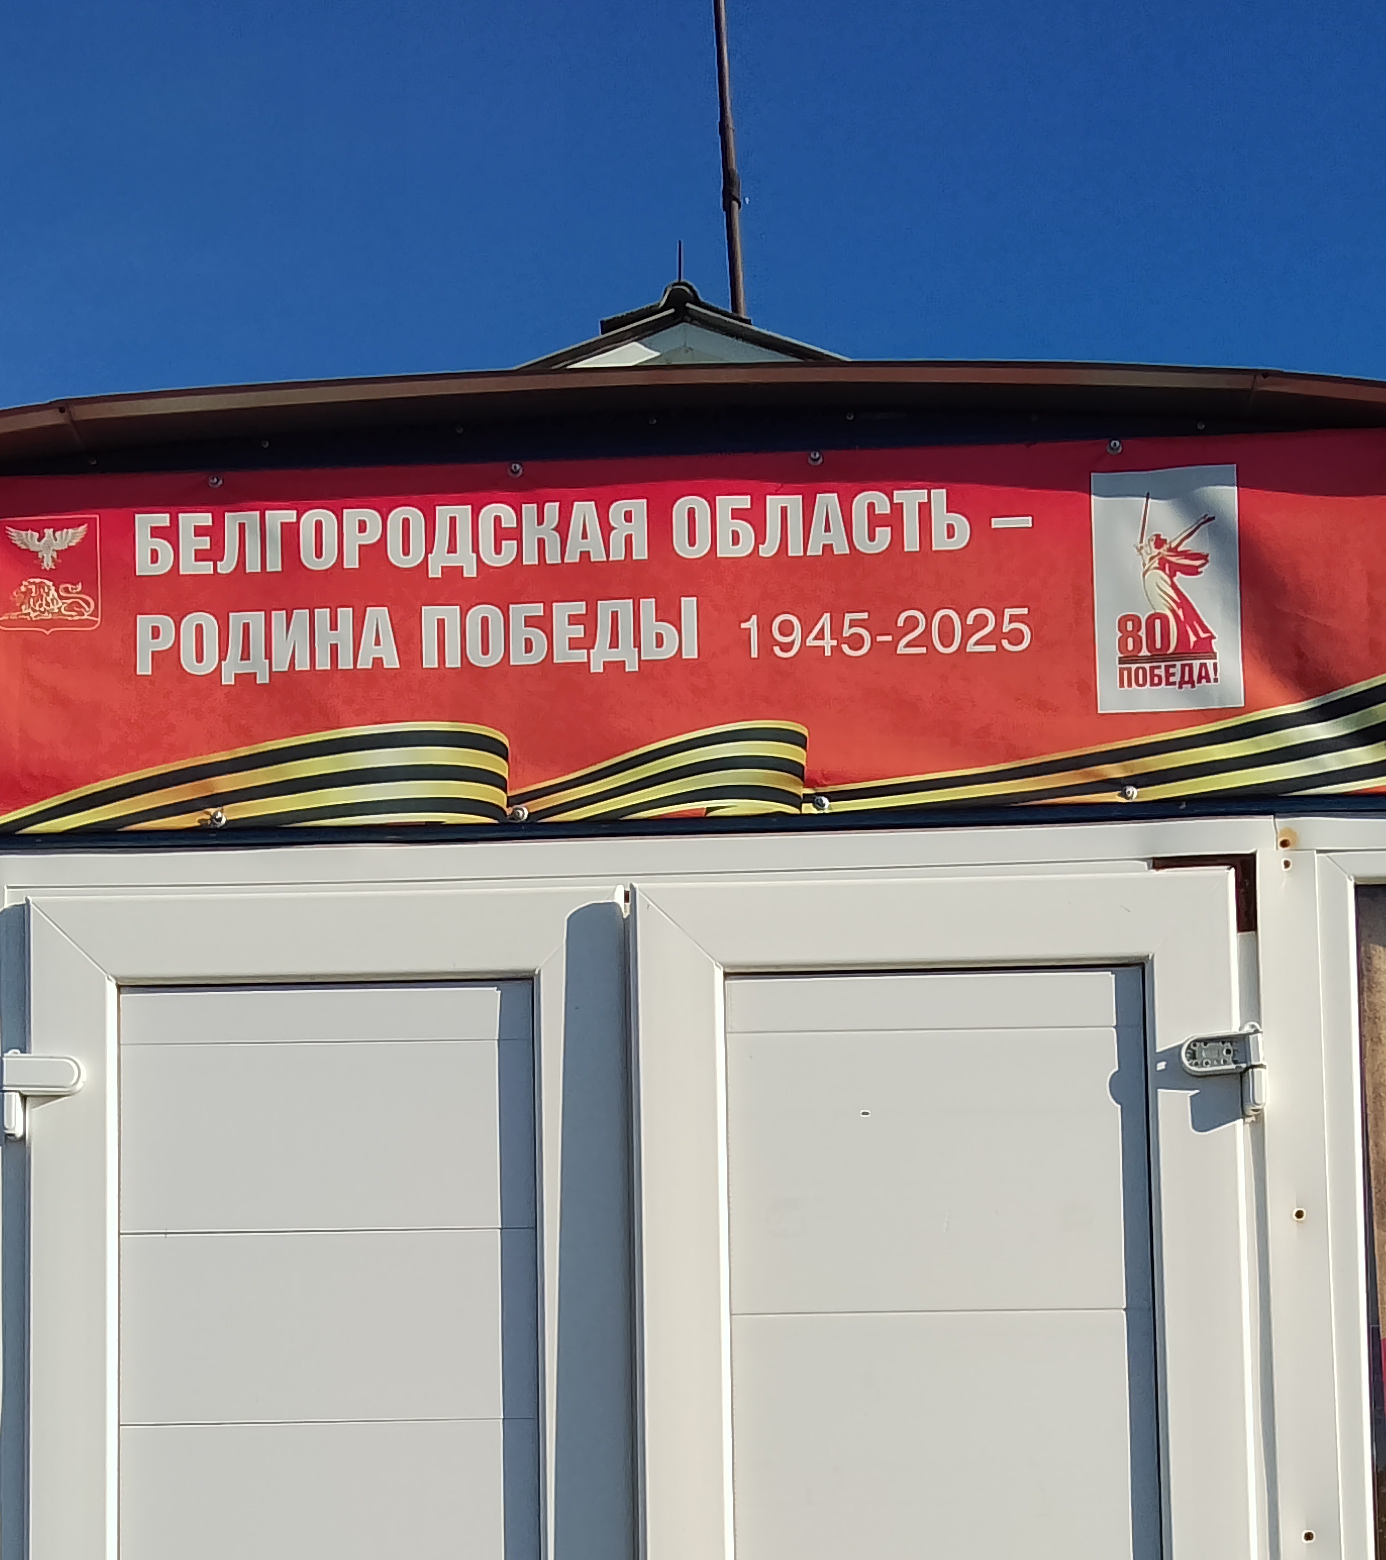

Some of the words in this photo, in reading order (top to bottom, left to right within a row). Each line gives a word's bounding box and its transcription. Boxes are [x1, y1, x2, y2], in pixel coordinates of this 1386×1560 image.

[134, 497, 652, 580] БЕЛГОРОДСКАЯ
[672, 489, 971, 560] ОБЛАСТЬ
[135, 603, 399, 684] РОДИНА
[418, 599, 699, 672] ПОБЕДЫ
[739, 606, 1032, 659] 1945-2025
[1116, 613, 1170, 659] 80
[1117, 659, 1220, 691] ПОБЕДА!
